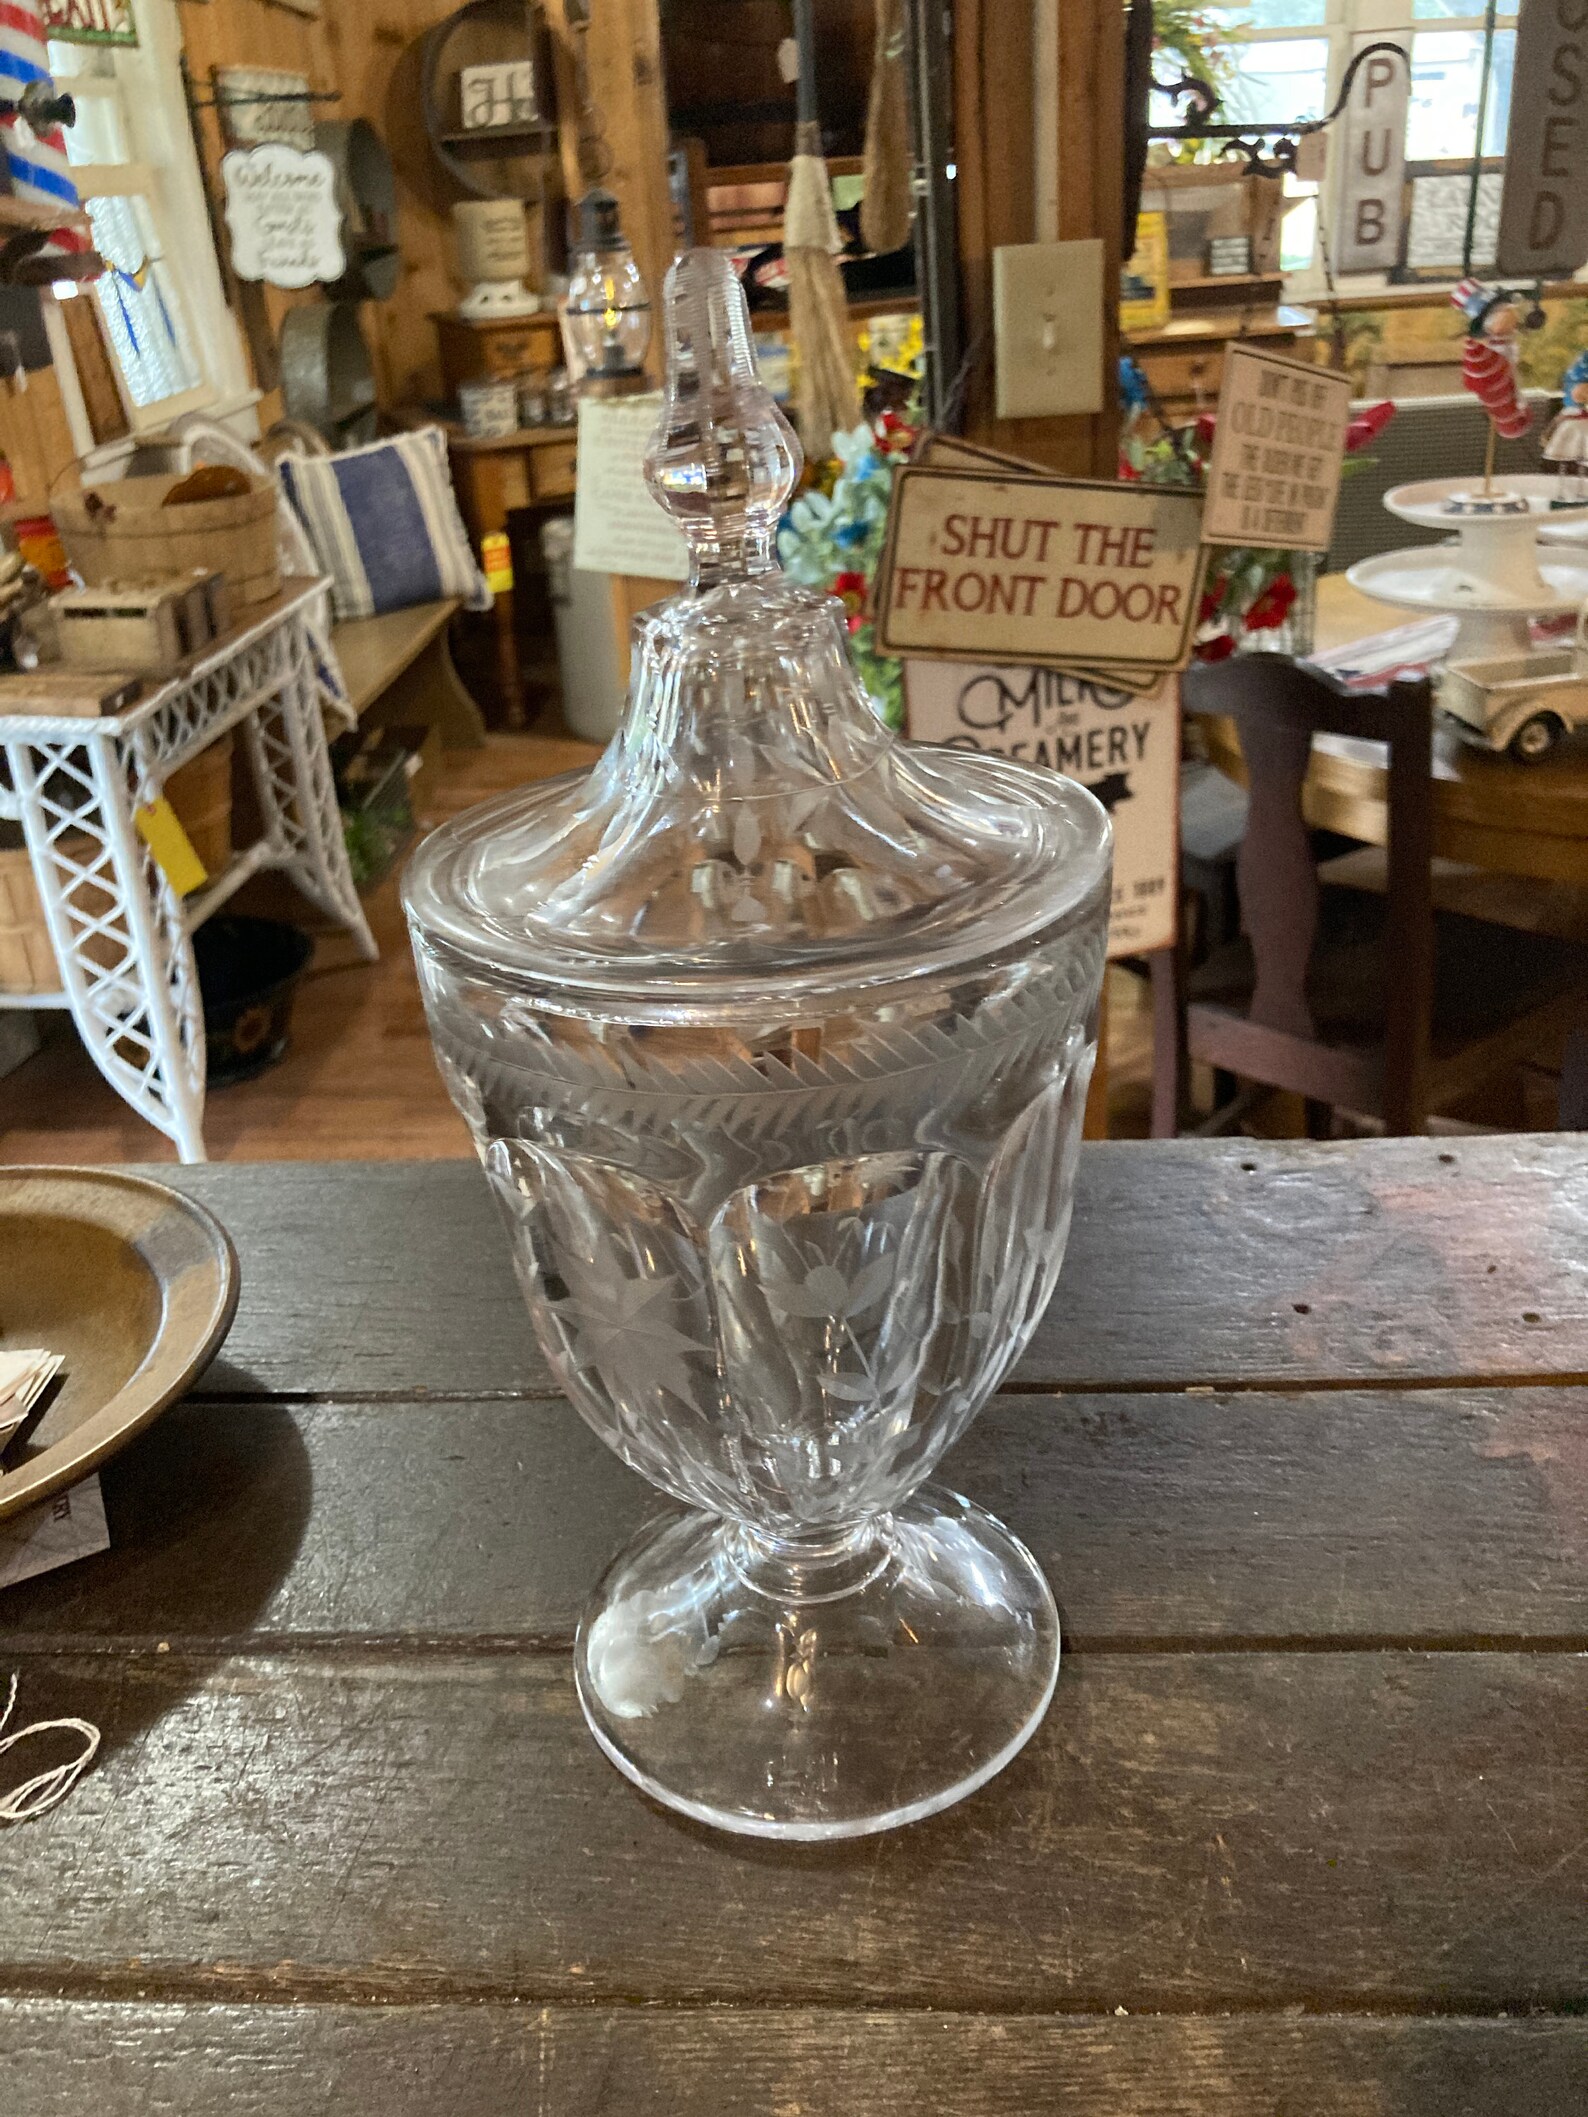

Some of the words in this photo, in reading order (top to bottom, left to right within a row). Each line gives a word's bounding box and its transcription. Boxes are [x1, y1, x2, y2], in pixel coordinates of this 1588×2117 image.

[1355, 58, 1396, 246] PUB
[942, 514, 1060, 562] SHUT
[1074, 523, 1157, 569] THE
[894, 567, 1046, 616] FRONT
[1056, 577, 1181, 625] DOOR
